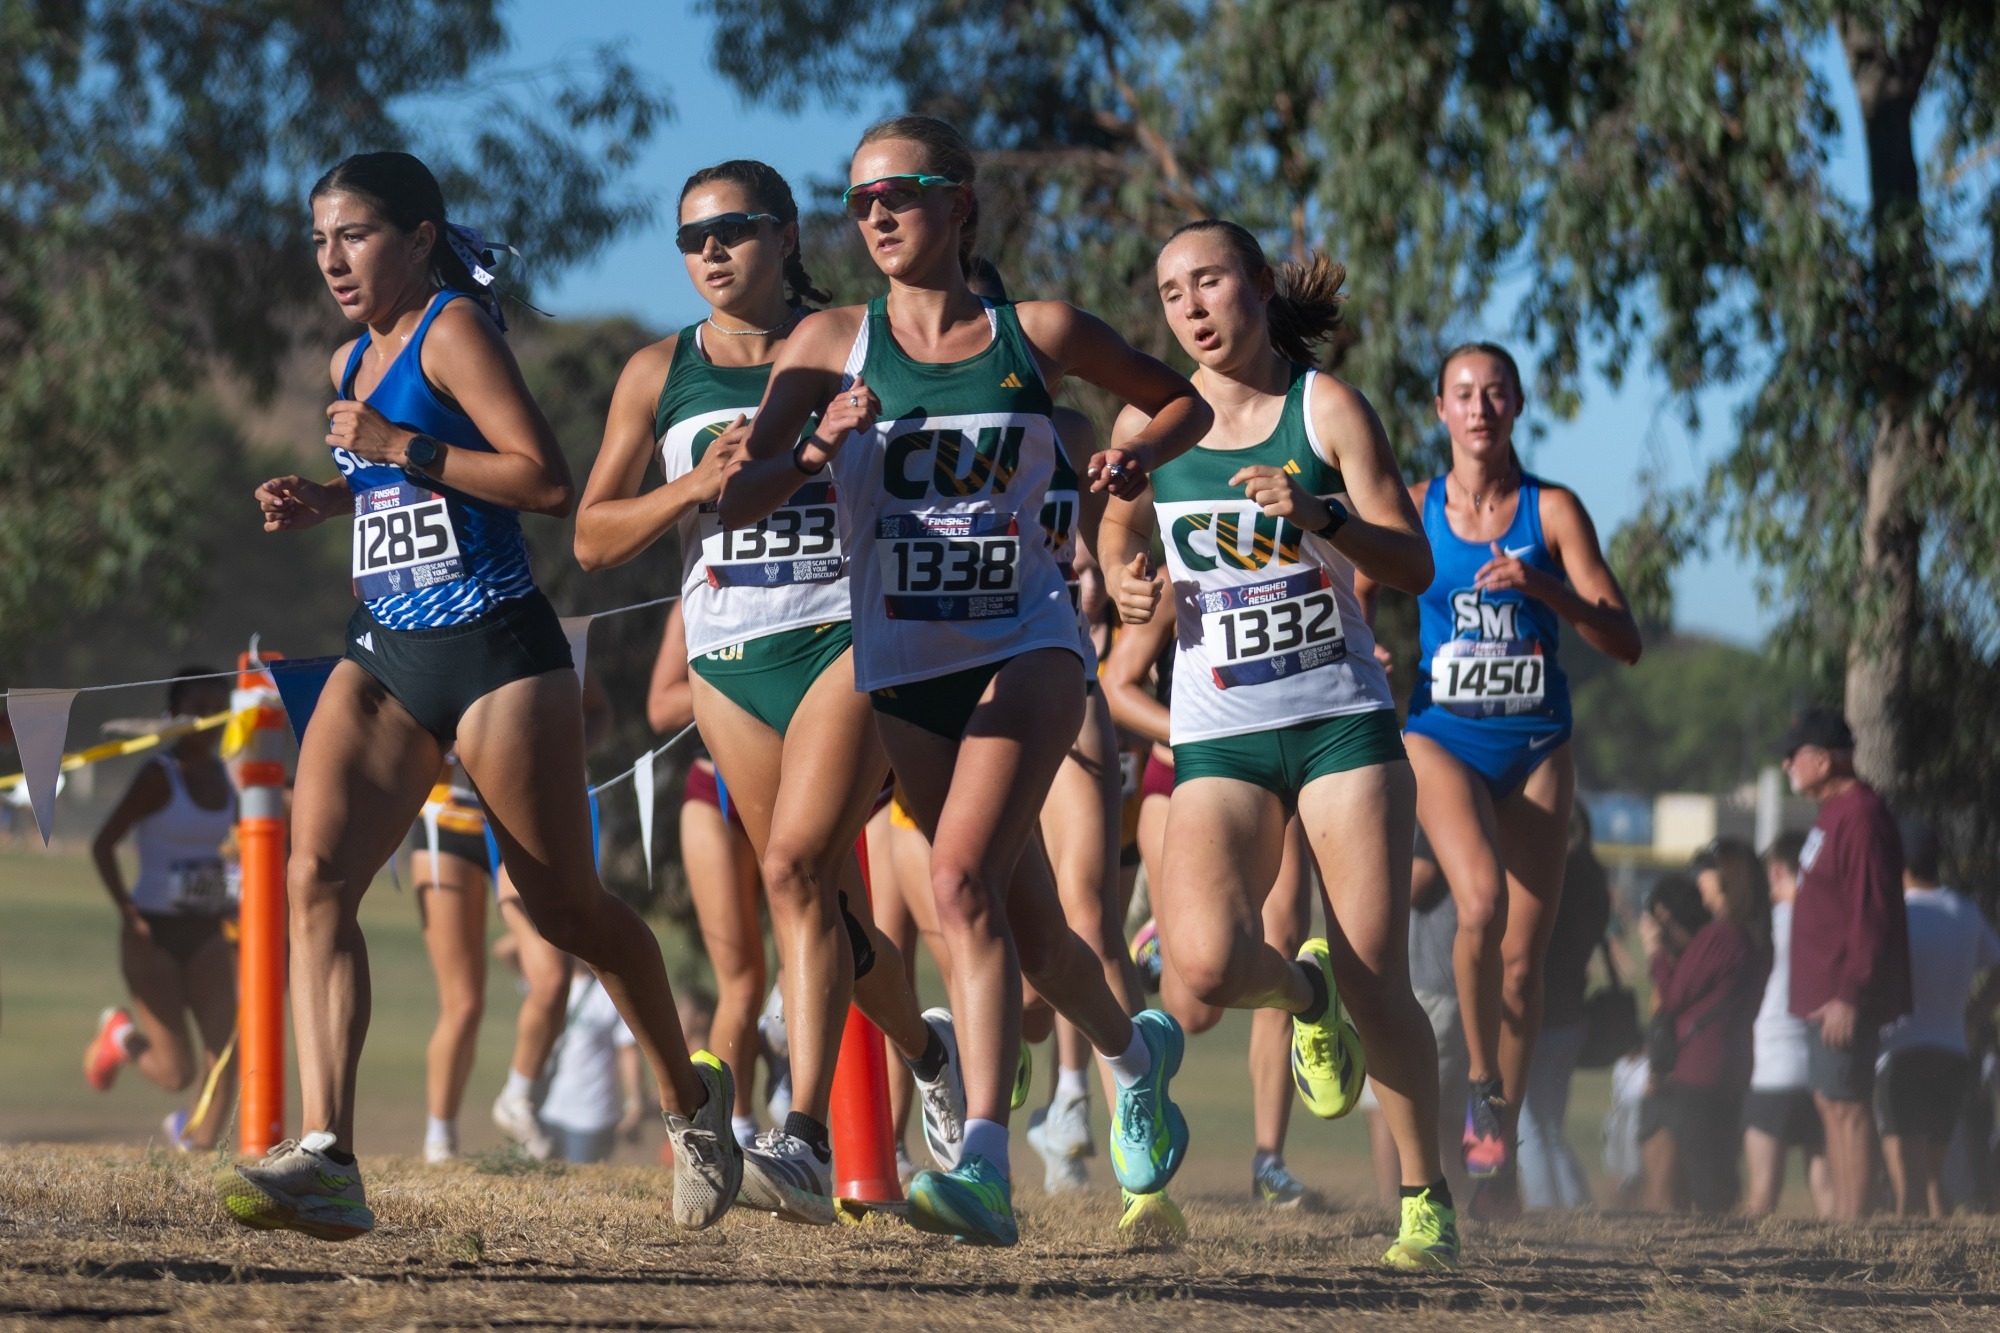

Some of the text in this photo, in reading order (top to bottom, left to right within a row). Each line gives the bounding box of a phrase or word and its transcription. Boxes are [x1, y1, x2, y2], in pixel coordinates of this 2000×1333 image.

[883, 426, 1025, 500] CUI
[374, 487, 400, 499] FINISHED
[374, 498, 400, 511] RESULTS
[716, 507, 836, 561] 1333
[926, 527, 970, 536] RESULTS
[928, 517, 972, 526] FINISHED
[357, 503, 449, 571] 1285
[1171, 511, 1303, 572] CUI
[430, 559, 458, 570] SCAN FOR
[432, 568, 448, 577] YOUR
[892, 540, 1017, 592] 1338
[1248, 581, 1287, 595] FINISHED
[1248, 590, 1287, 605] RESULTS
[1219, 593, 1336, 661] 1332
[1453, 591, 1514, 640] SM
[1447, 659, 1542, 697] 1450
